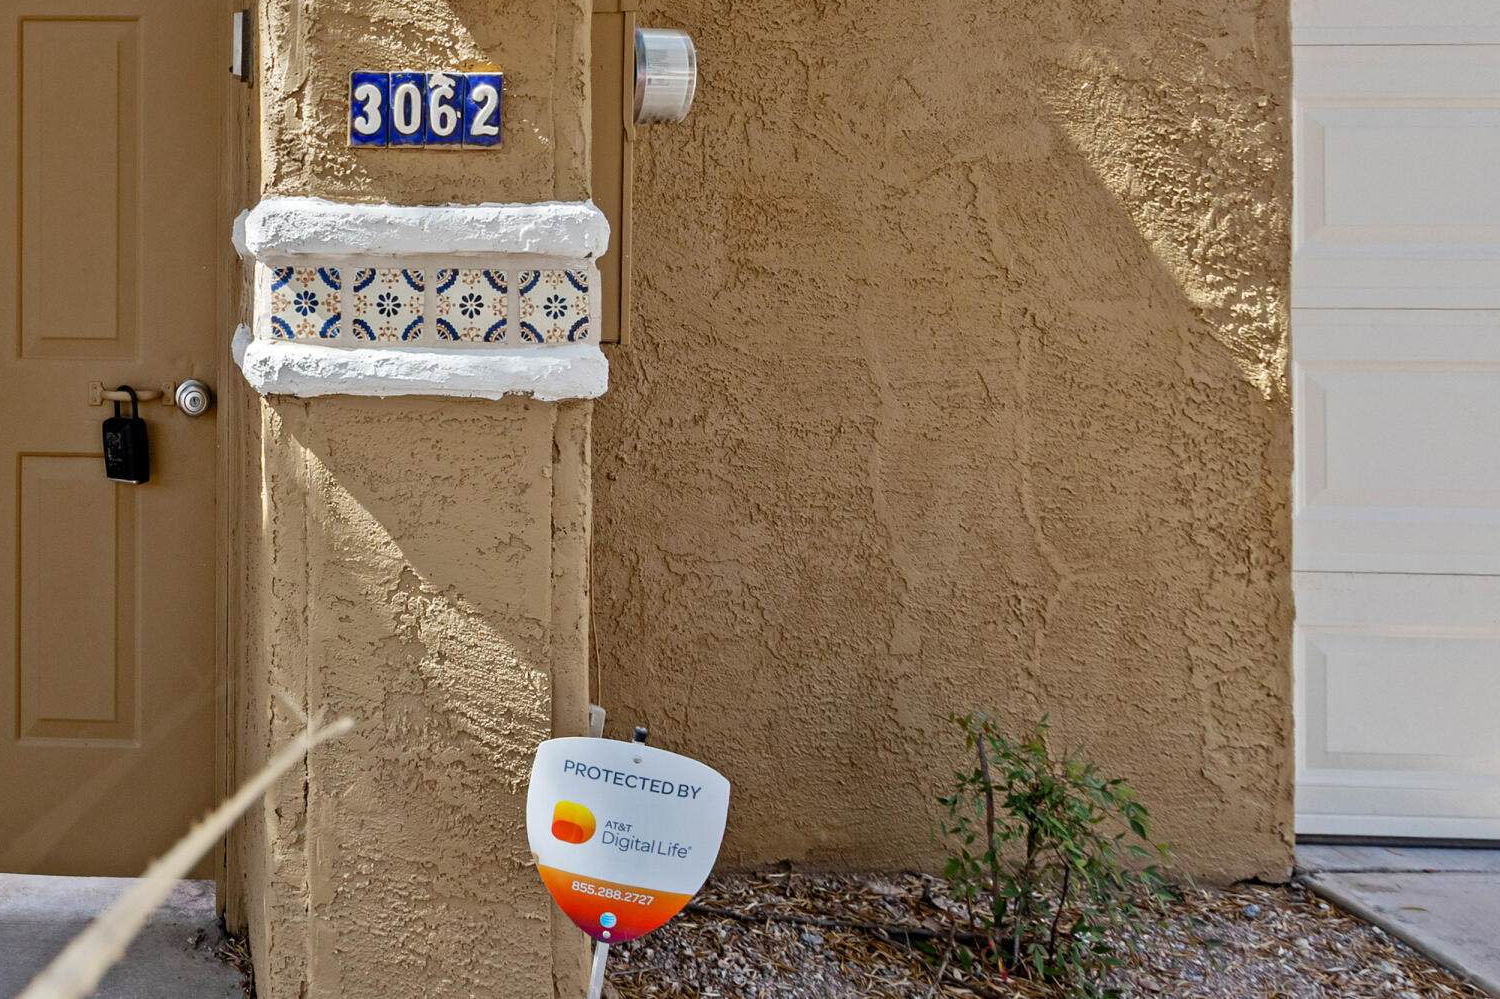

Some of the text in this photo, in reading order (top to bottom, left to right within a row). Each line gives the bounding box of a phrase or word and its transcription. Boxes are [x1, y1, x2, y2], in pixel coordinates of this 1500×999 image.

[353, 83, 499, 137] 3062
[564, 759, 702, 800] PROTECTED BY
[605, 820, 633, 833] AT&T
[602, 830, 656, 853] Digital
[571, 880, 655, 906] 855.288.2727
